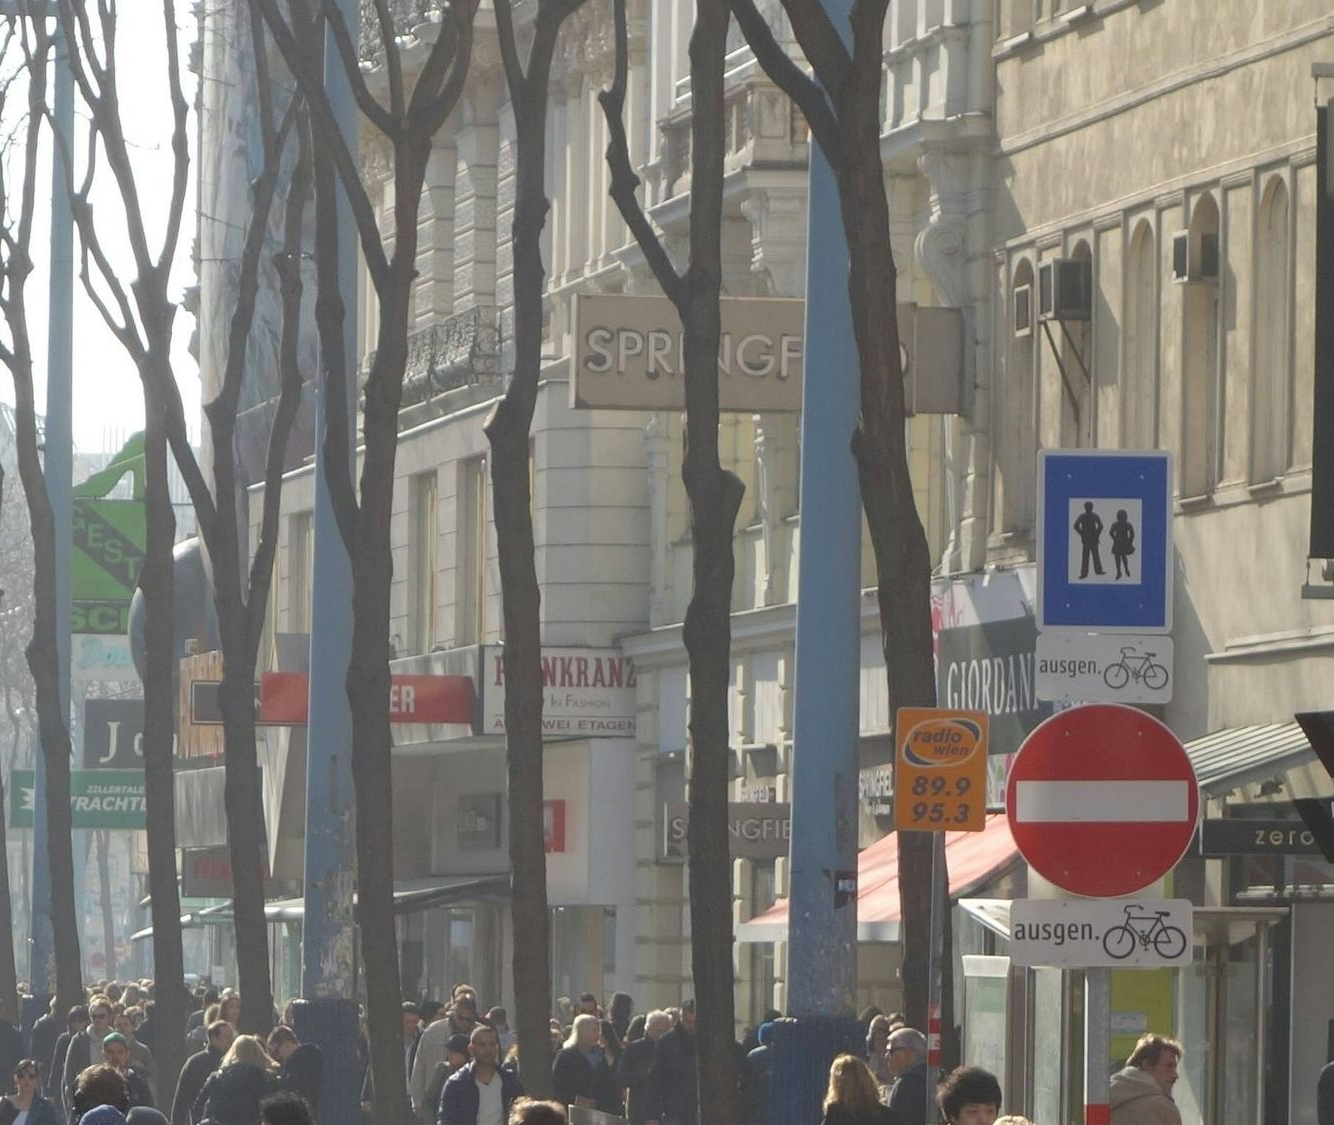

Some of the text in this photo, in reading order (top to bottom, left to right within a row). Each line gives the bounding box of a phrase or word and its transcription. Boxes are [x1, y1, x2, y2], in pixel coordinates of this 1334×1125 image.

[1039, 658, 1102, 678] ausgen.
[947, 653, 1038, 714] GIORDAN
[913, 728, 962, 742] radio
[933, 744, 969, 756] wien
[911, 776, 971, 797] 89.9
[911, 803, 971, 823] 95.3
[1254, 829, 1315, 846] zero
[1014, 919, 1100, 945] ausgen.
